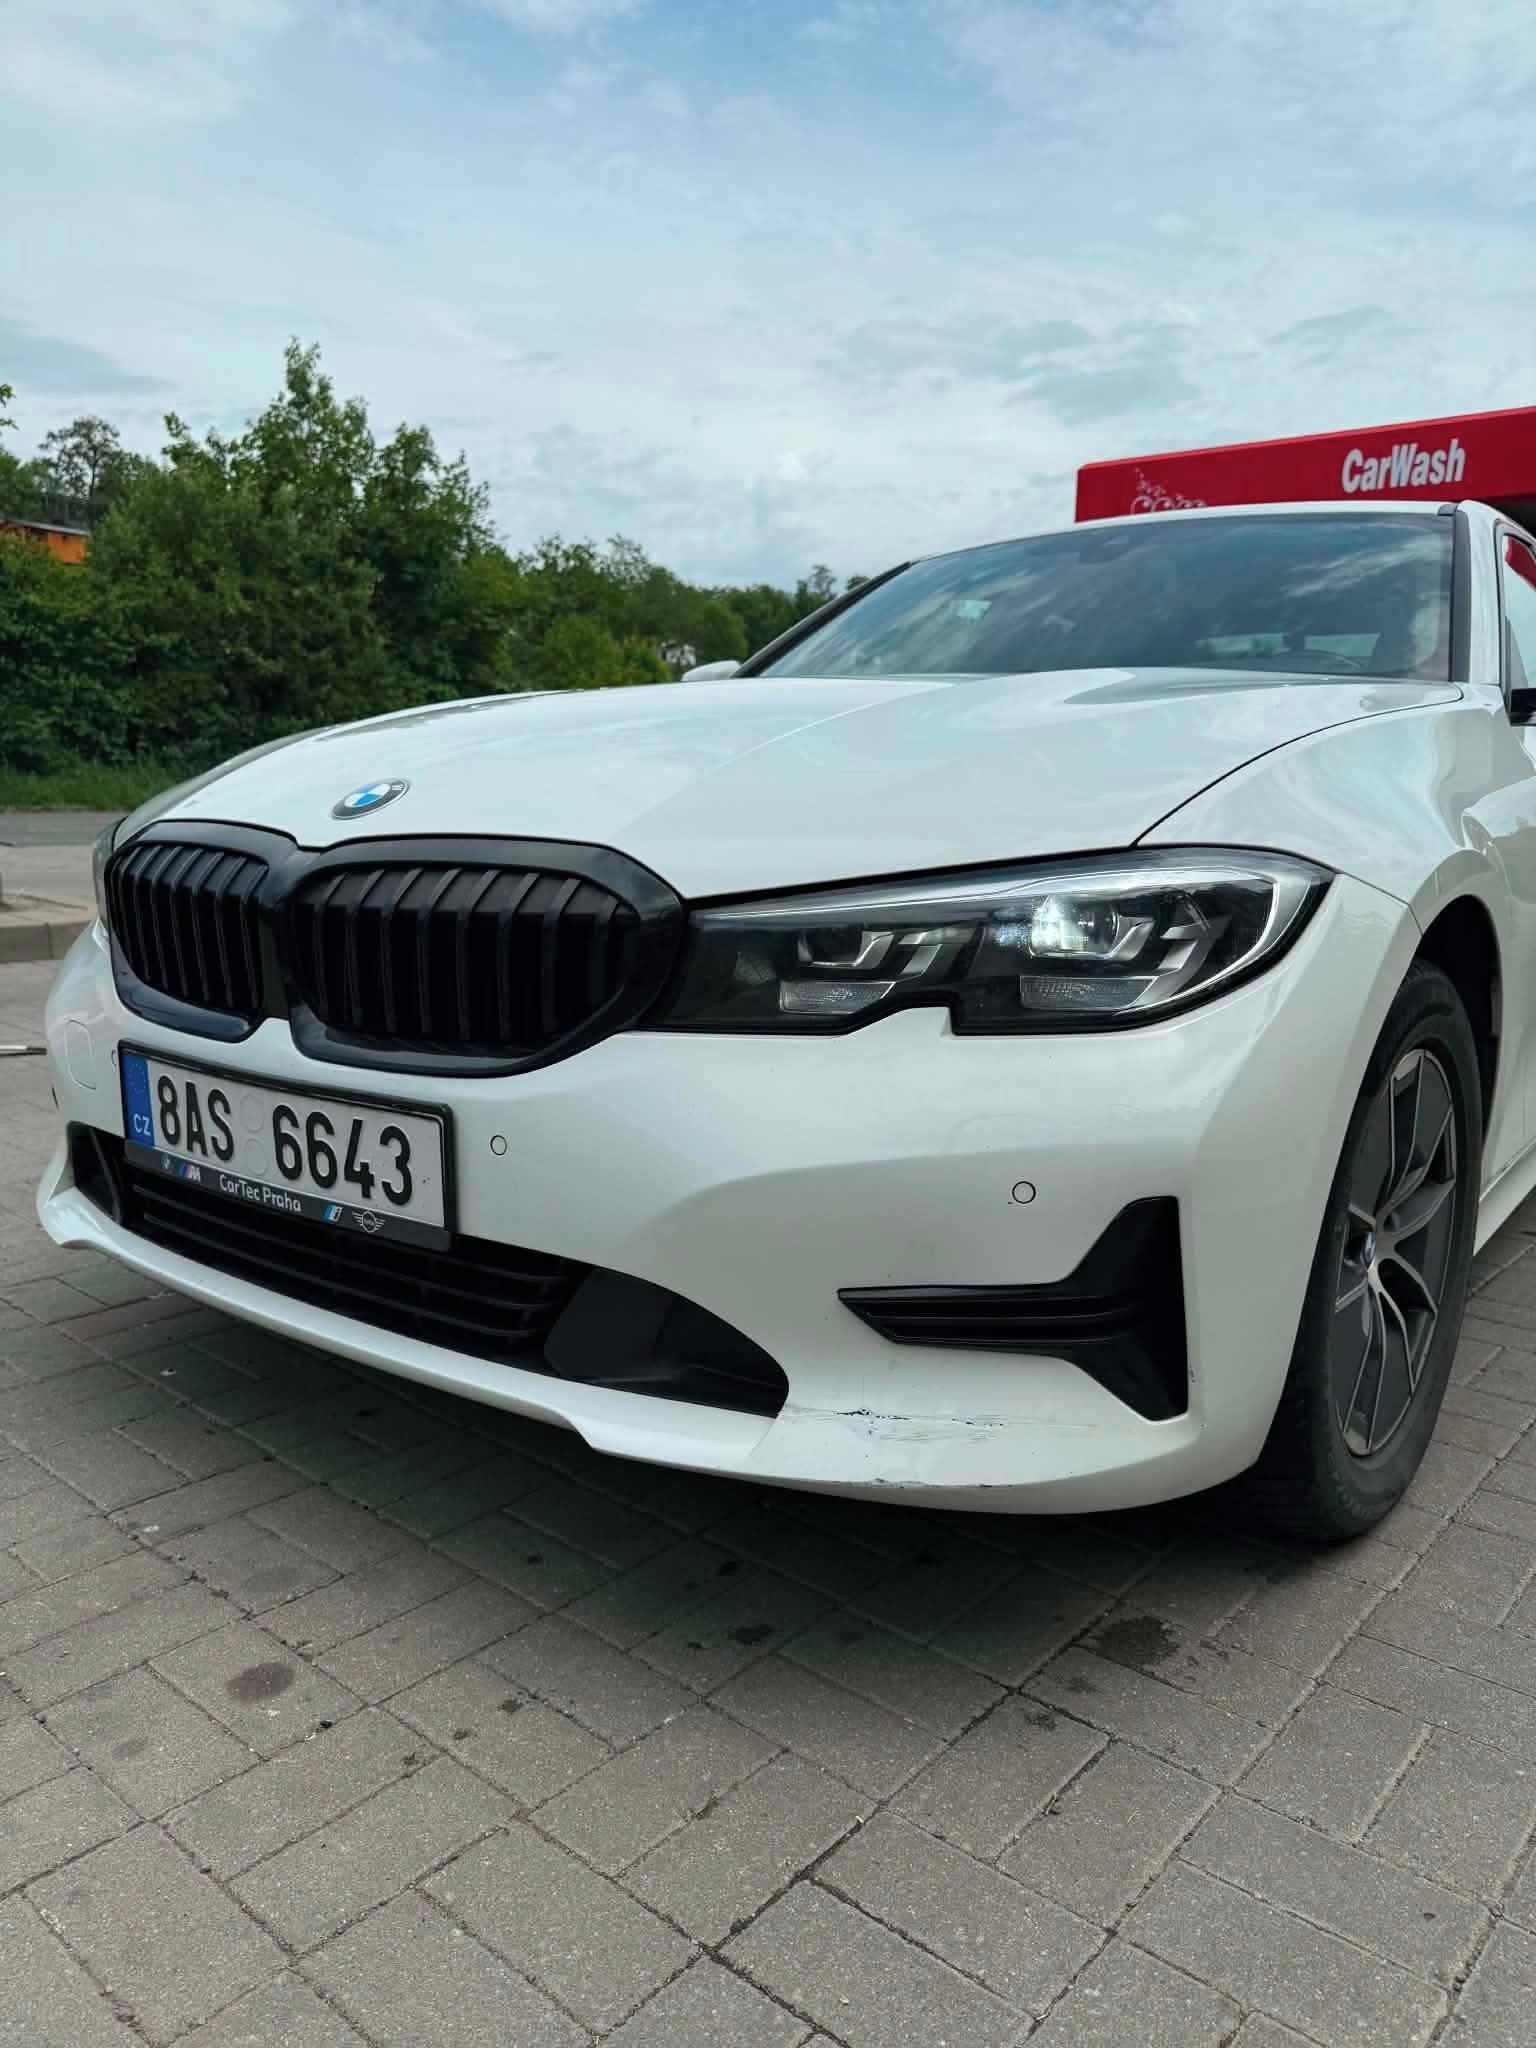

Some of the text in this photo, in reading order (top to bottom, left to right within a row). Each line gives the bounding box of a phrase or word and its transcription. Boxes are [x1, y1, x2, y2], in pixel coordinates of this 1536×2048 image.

[1342, 438, 1465, 493] CarWash
[133, 1112, 152, 1137] CZ
[157, 1074, 413, 1206] 8AS 6643
[219, 1174, 260, 1201] CarTec
[263, 1190, 302, 1213] Praha
